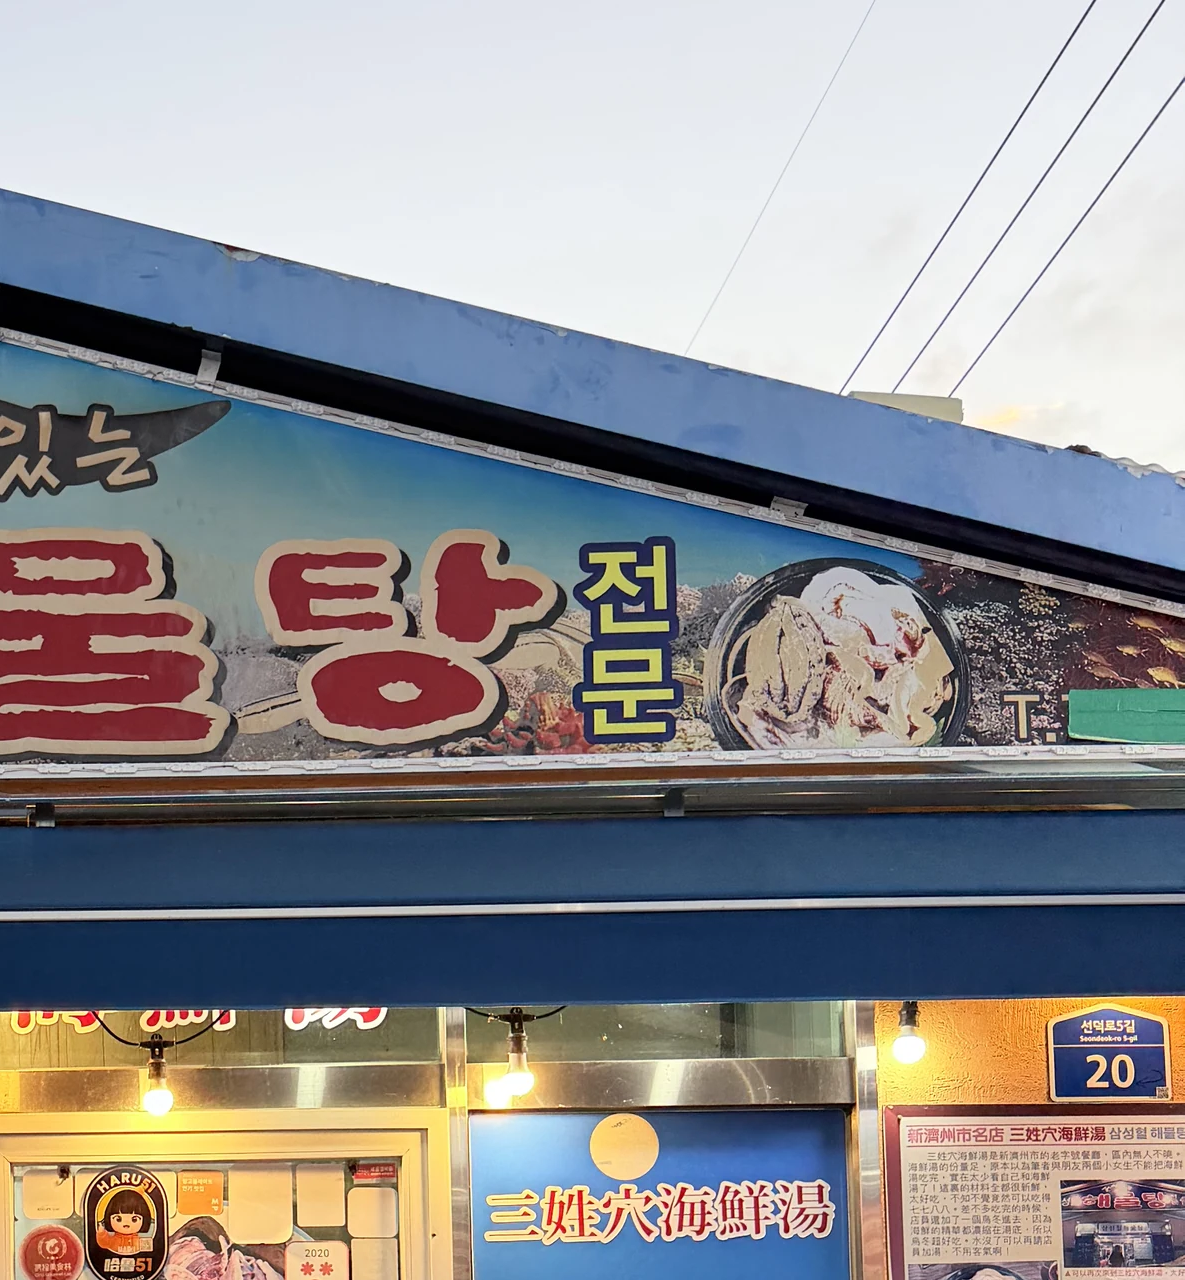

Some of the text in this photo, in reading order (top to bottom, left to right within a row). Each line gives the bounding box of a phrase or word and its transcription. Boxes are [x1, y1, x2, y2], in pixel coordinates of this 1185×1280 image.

[578, 540, 676, 741] 전문
[1080, 1020, 1135, 1033] 선덕로5길
[1086, 1054, 1135, 1088] 20
[907, 1127, 1005, 1144] 新濟州市名店
[1009, 1126, 1106, 1143] 三姓穴海鮮湯
[484, 1180, 836, 1245] 三姓穴海鮮湯
[305, 1249, 330, 1257] 2020
